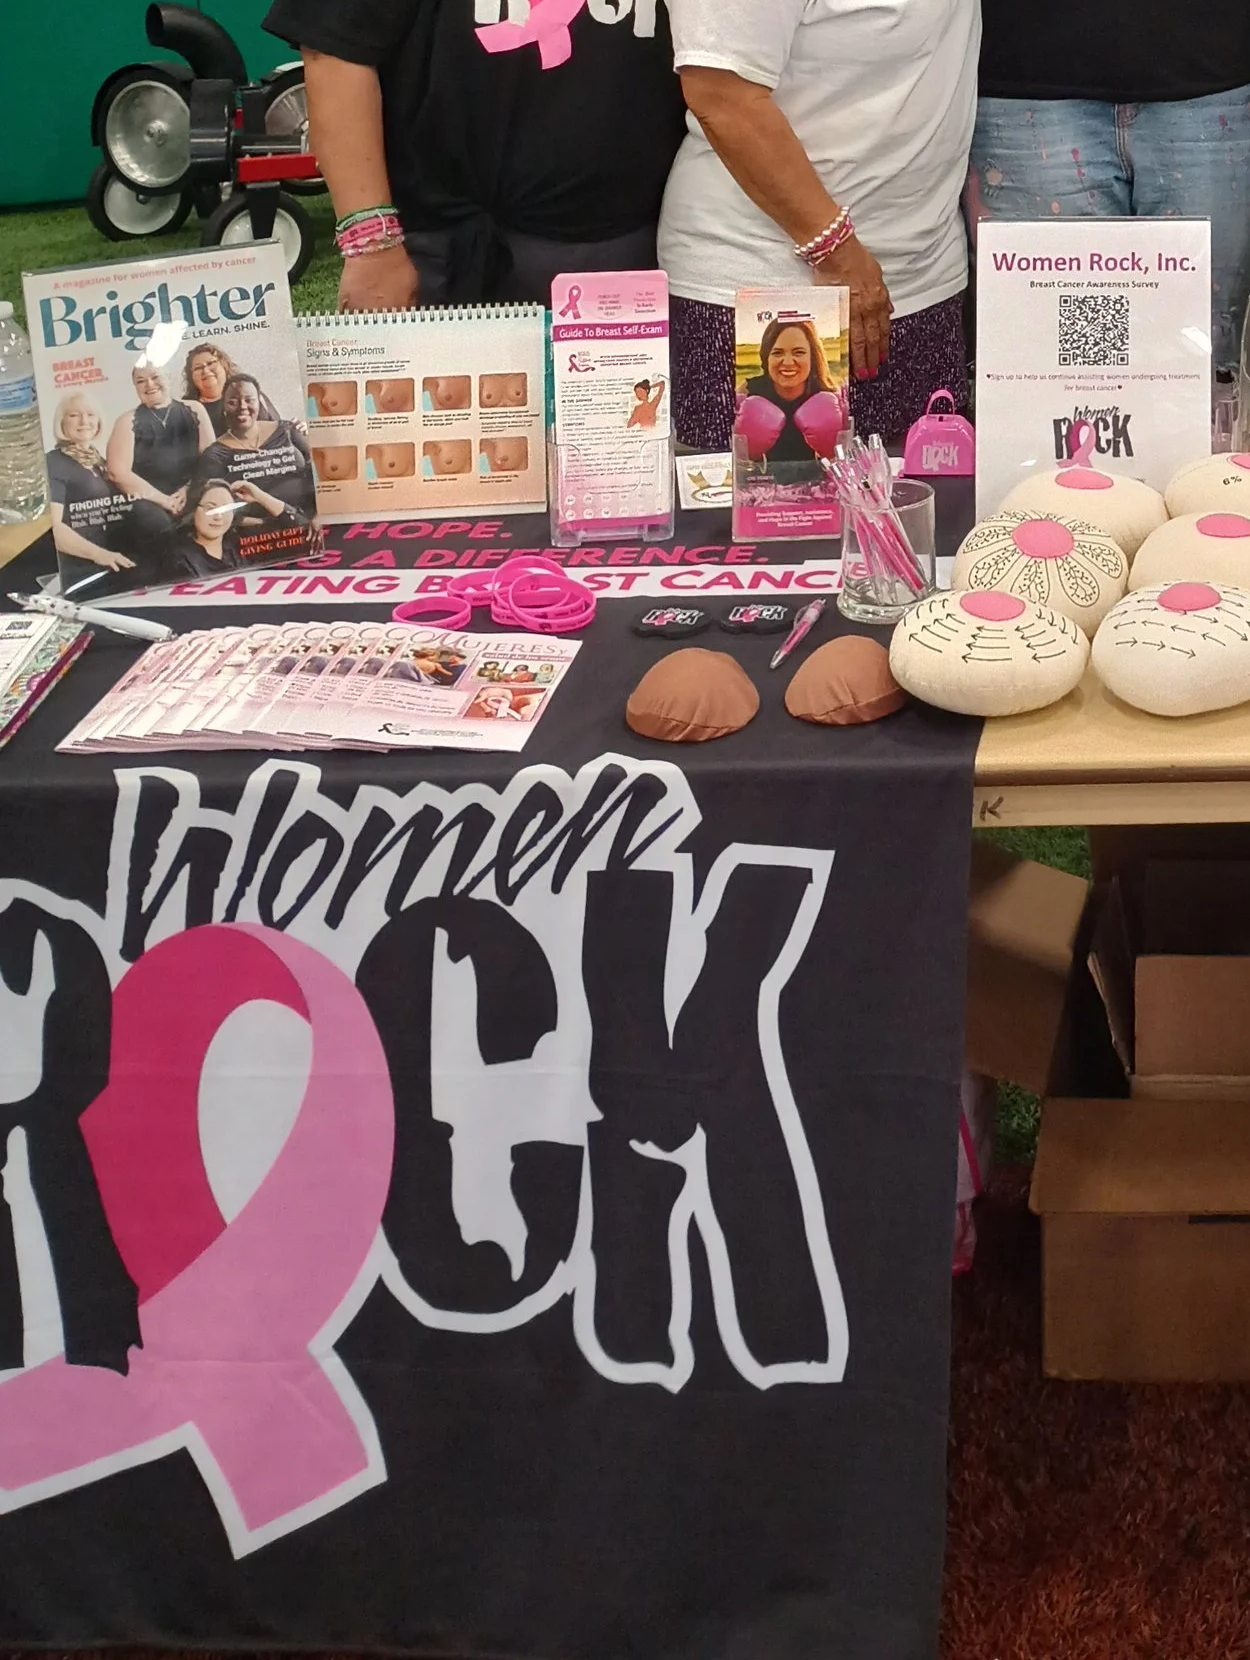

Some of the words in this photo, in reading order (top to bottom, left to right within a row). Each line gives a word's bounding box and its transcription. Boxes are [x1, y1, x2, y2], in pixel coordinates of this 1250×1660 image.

[113, 271, 128, 282] for
[130, 268, 168, 280] women
[169, 262, 210, 276] affected
[225, 256, 256, 267] cancer
[992, 252, 1081, 272] Women
[1089, 252, 1150, 275] Rock,
[1157, 252, 1197, 272] Inc.
[1029, 280, 1056, 288] Breast
[1057, 280, 1085, 288] Cancer
[1086, 280, 1130, 288] Awareness
[1131, 280, 1160, 289] Survey
[39, 282, 276, 351] Brighter
[192, 326, 232, 339] LEARN.
[234, 320, 271, 333] SHINE.
[560, 328, 583, 338] Guide
[584, 327, 595, 337] To
[595, 326, 622, 337] Breast
[623, 324, 663, 336] Self-Exam
[306, 348, 331, 359] Signs
[331, 347, 339, 356] &
[341, 346, 385, 358] Symptoms
[1073, 405, 1120, 420] Women
[1053, 414, 1134, 468] ROCK
[69, 496, 112, 512] FINDING
[112, 495, 126, 505] FA
[343, 521, 513, 540] HOPE.
[352, 549, 398, 569] A
[979, 796, 1004, 822] K
[117, 758, 692, 960] Women
